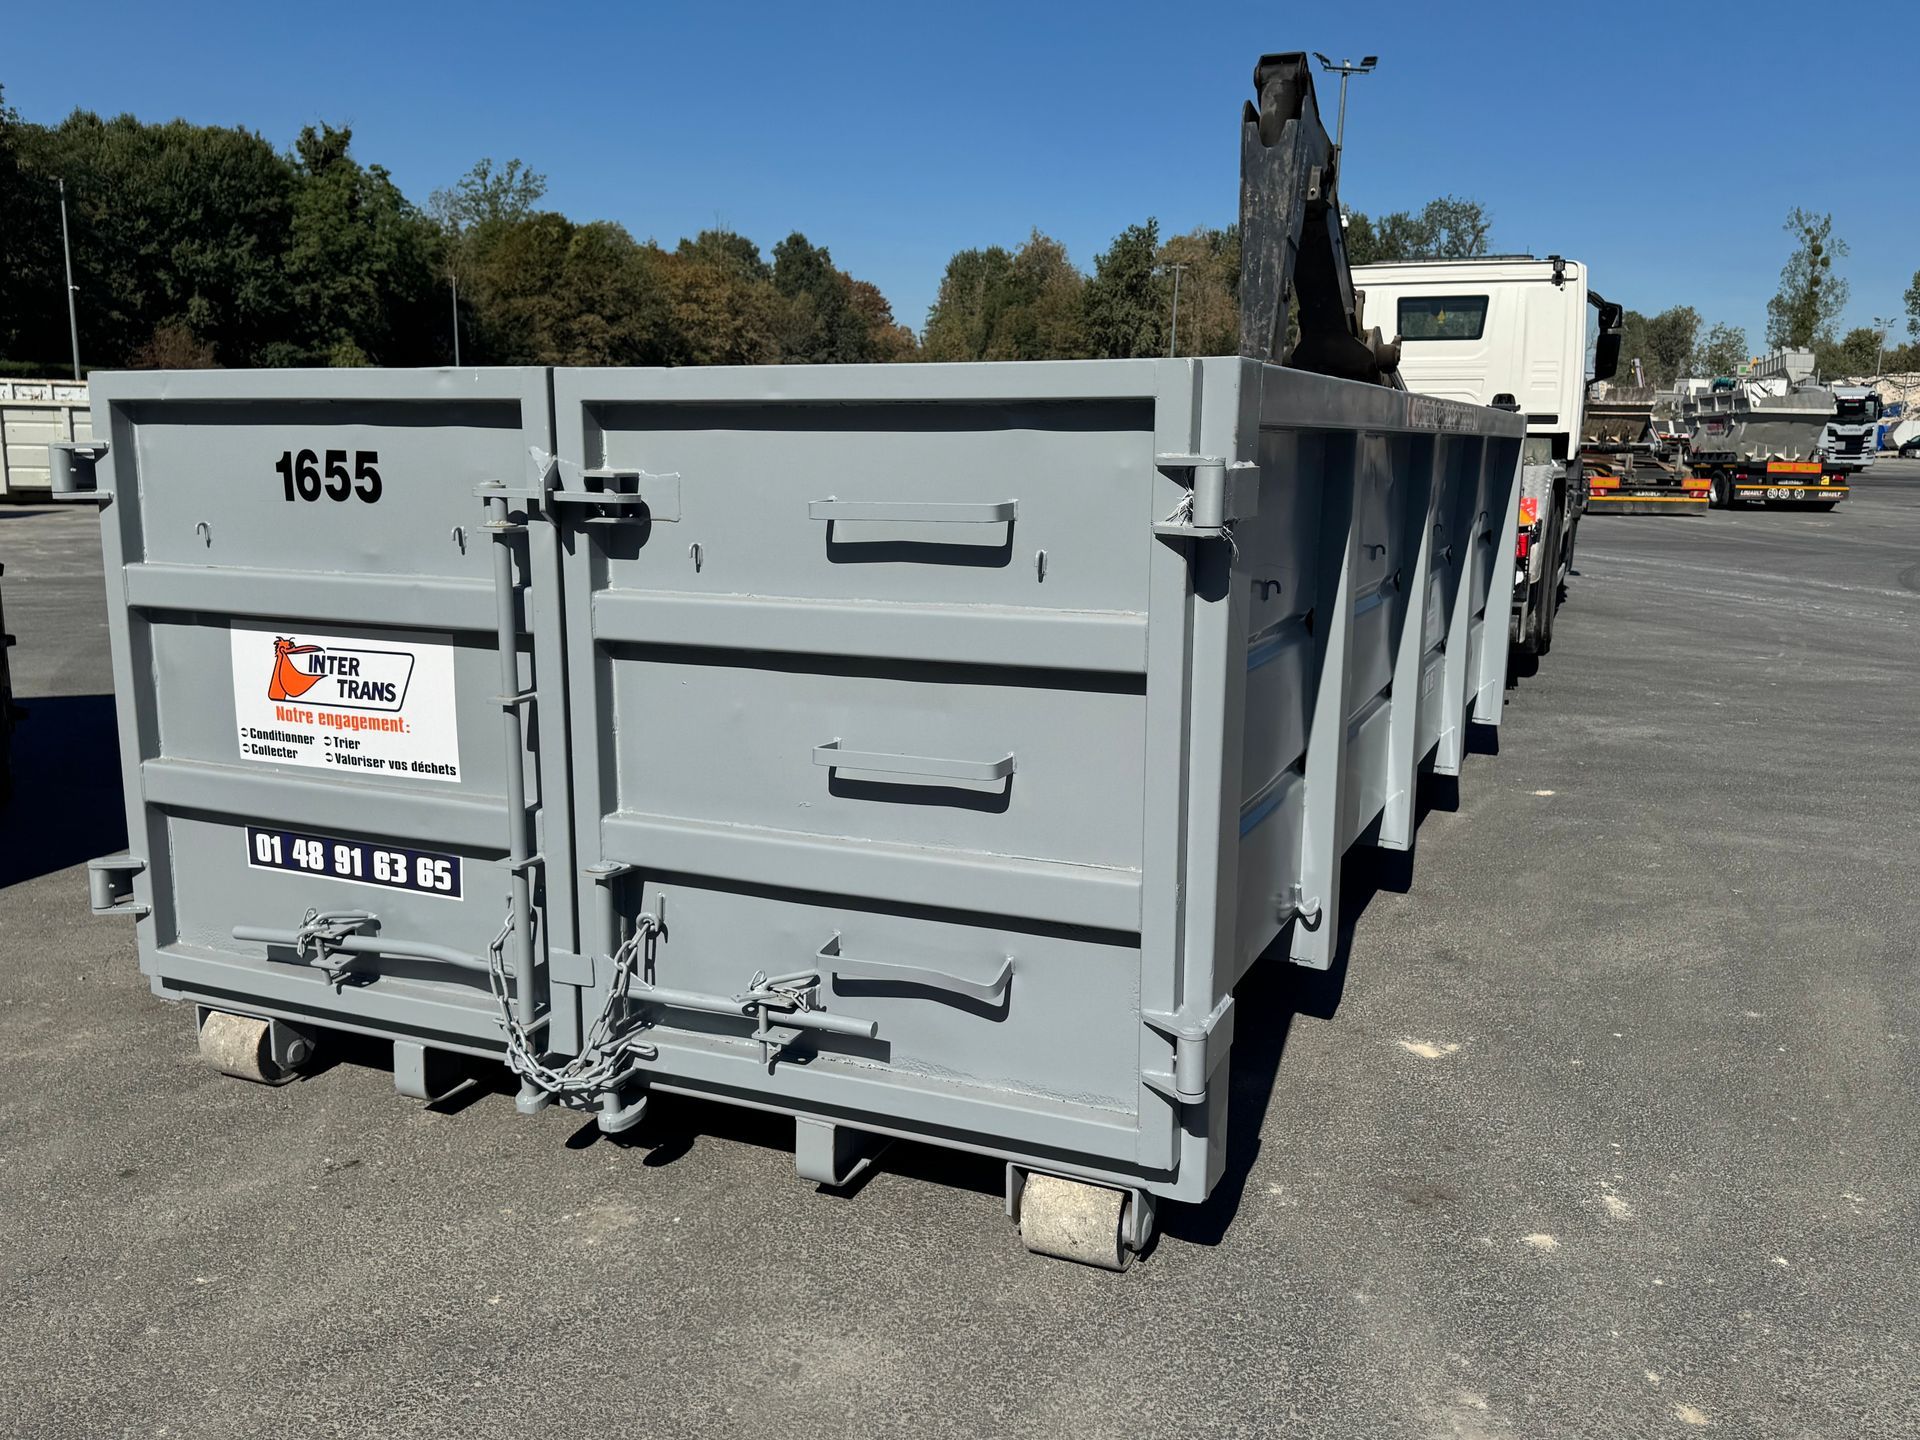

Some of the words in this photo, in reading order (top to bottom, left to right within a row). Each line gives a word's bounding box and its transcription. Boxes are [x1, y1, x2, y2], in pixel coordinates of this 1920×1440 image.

[275, 448, 382, 504] 1655
[308, 654, 360, 677] INTER
[336, 679, 397, 703] TRANS
[276, 705, 314, 724] Notre
[249, 728, 316, 746] Conditionner
[333, 737, 361, 750] Trier
[251, 744, 298, 759] Collecter
[335, 753, 386, 769] Valoriser
[388, 759, 408, 771] vos
[411, 760, 457, 776] déchets
[256, 833, 283, 864] 01
[292, 839, 324, 870] 48
[334, 846, 362, 877] 91
[373, 851, 407, 883] 63
[416, 857, 452, 891] 65
